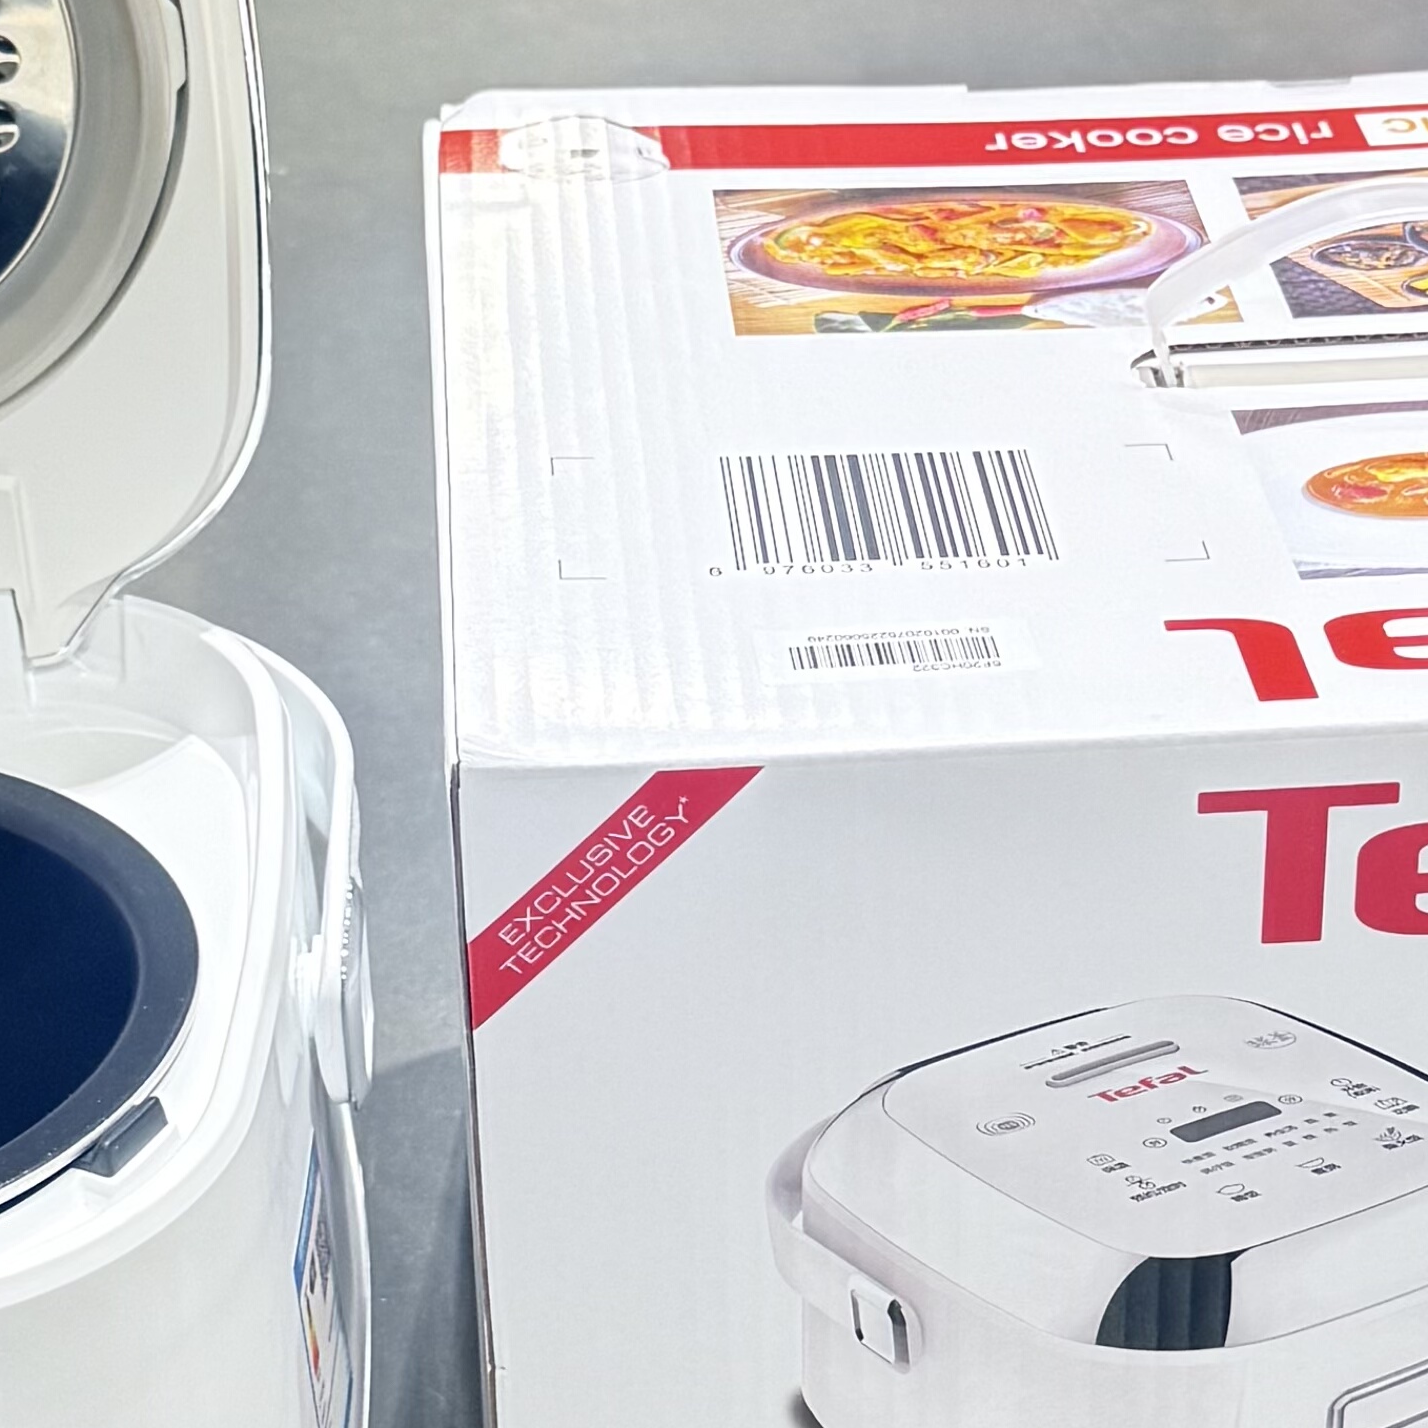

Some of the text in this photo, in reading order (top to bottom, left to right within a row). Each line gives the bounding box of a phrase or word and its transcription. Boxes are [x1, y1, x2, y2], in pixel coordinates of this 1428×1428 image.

[985, 122, 1199, 154] cooker
[1217, 119, 1333, 146] rice
[764, 563, 873, 575] 976033
[922, 558, 1027, 570] 551601
[498, 804, 655, 946] EXCLUSIVE
[1087, 1066, 1209, 1103] Tefal
